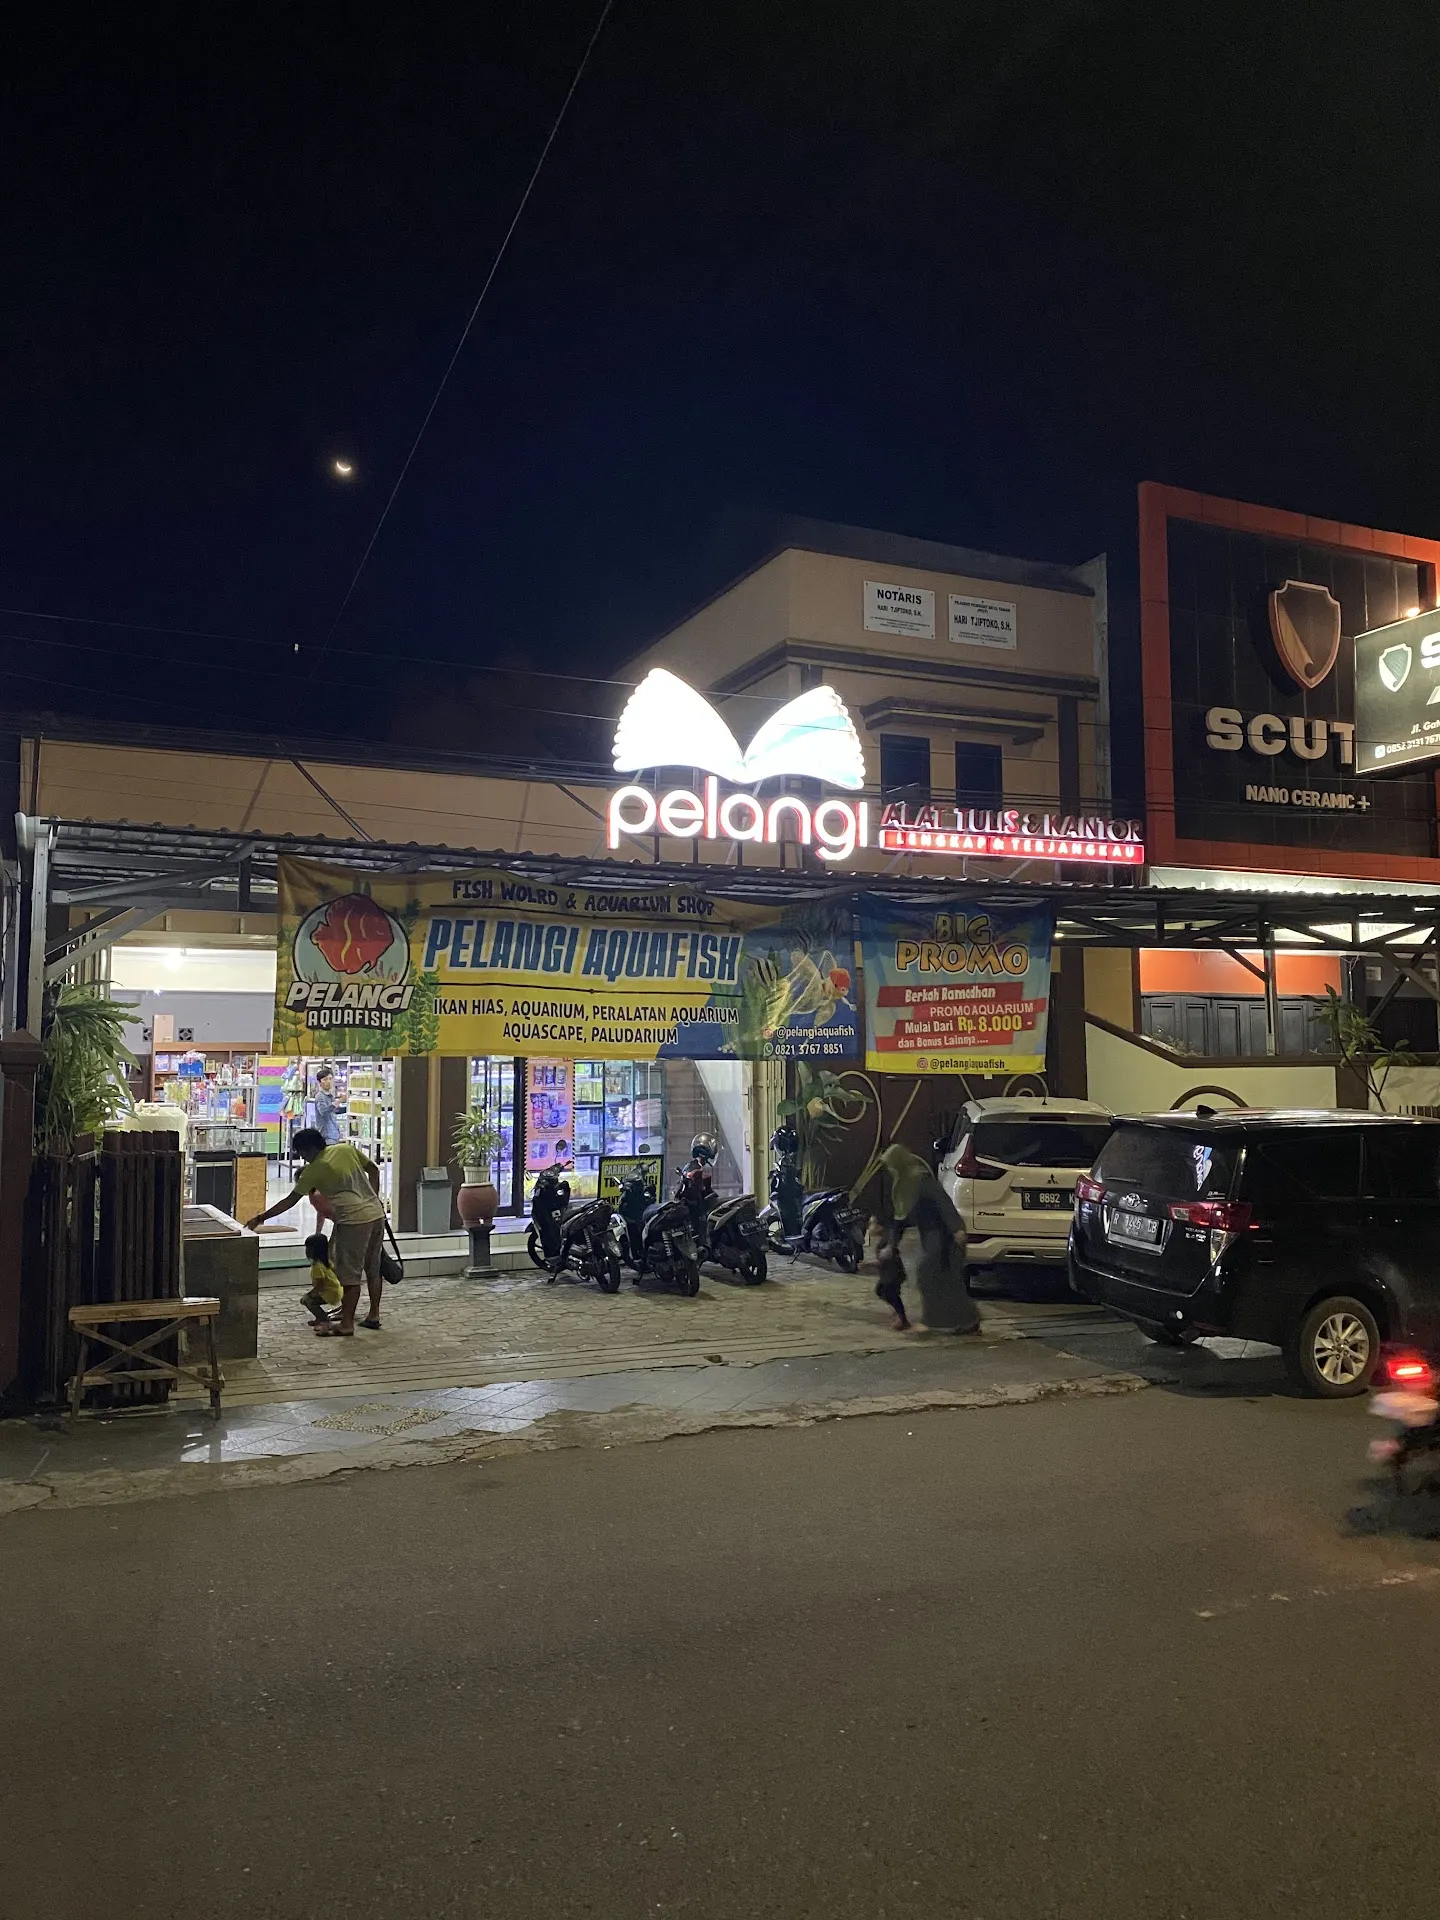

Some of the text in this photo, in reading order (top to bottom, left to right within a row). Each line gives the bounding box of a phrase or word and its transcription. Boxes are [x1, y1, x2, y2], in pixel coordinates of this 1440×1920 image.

[877, 588, 922, 605] NOTARIS
[954, 614, 968, 625] HARI
[1246, 784, 1289, 804] NANO
[1291, 789, 1355, 809] CERAMIC
[607, 775, 868, 861] pelangi
[881, 802, 1143, 842] ALAT TULIS & KANTOR
[896, 832, 986, 850] LENGKAP
[1012, 838, 1135, 858] TERJANGKAU
[453, 880, 715, 917] FISH WOLRD & AQUARIUM SHOP
[936, 913, 991, 946] BIG
[423, 918, 741, 982] PELANGI AQUAFISH
[897, 941, 1030, 976] PROMO
[285, 981, 415, 1010] PELANGI
[905, 986, 996, 1003] Berkah Ramadhan
[308, 1009, 392, 1028] AQUAFISH
[433, 998, 739, 1026] IKAN HIAS, AQUARIUM, PERALATAN AQUARIUM
[930, 1003, 1034, 1017] PROMO AQUARIUM
[502, 1022, 678, 1044] AQUASCAPE, PALUDARIUM
[776, 1025, 855, 1040] @pelangiaquafish
[905, 1021, 931, 1034] Mulai
[933, 1019, 953, 1032] Dari
[957, 1016, 976, 1034] Rp.
[775, 1043, 844, 1055] 0821 3767 8851
[898, 1036, 915, 1048] dan
[917, 1036, 942, 1048] Bonus
[1024, 1193, 1031, 1203] R
[1113, 1213, 1120, 1225] R
